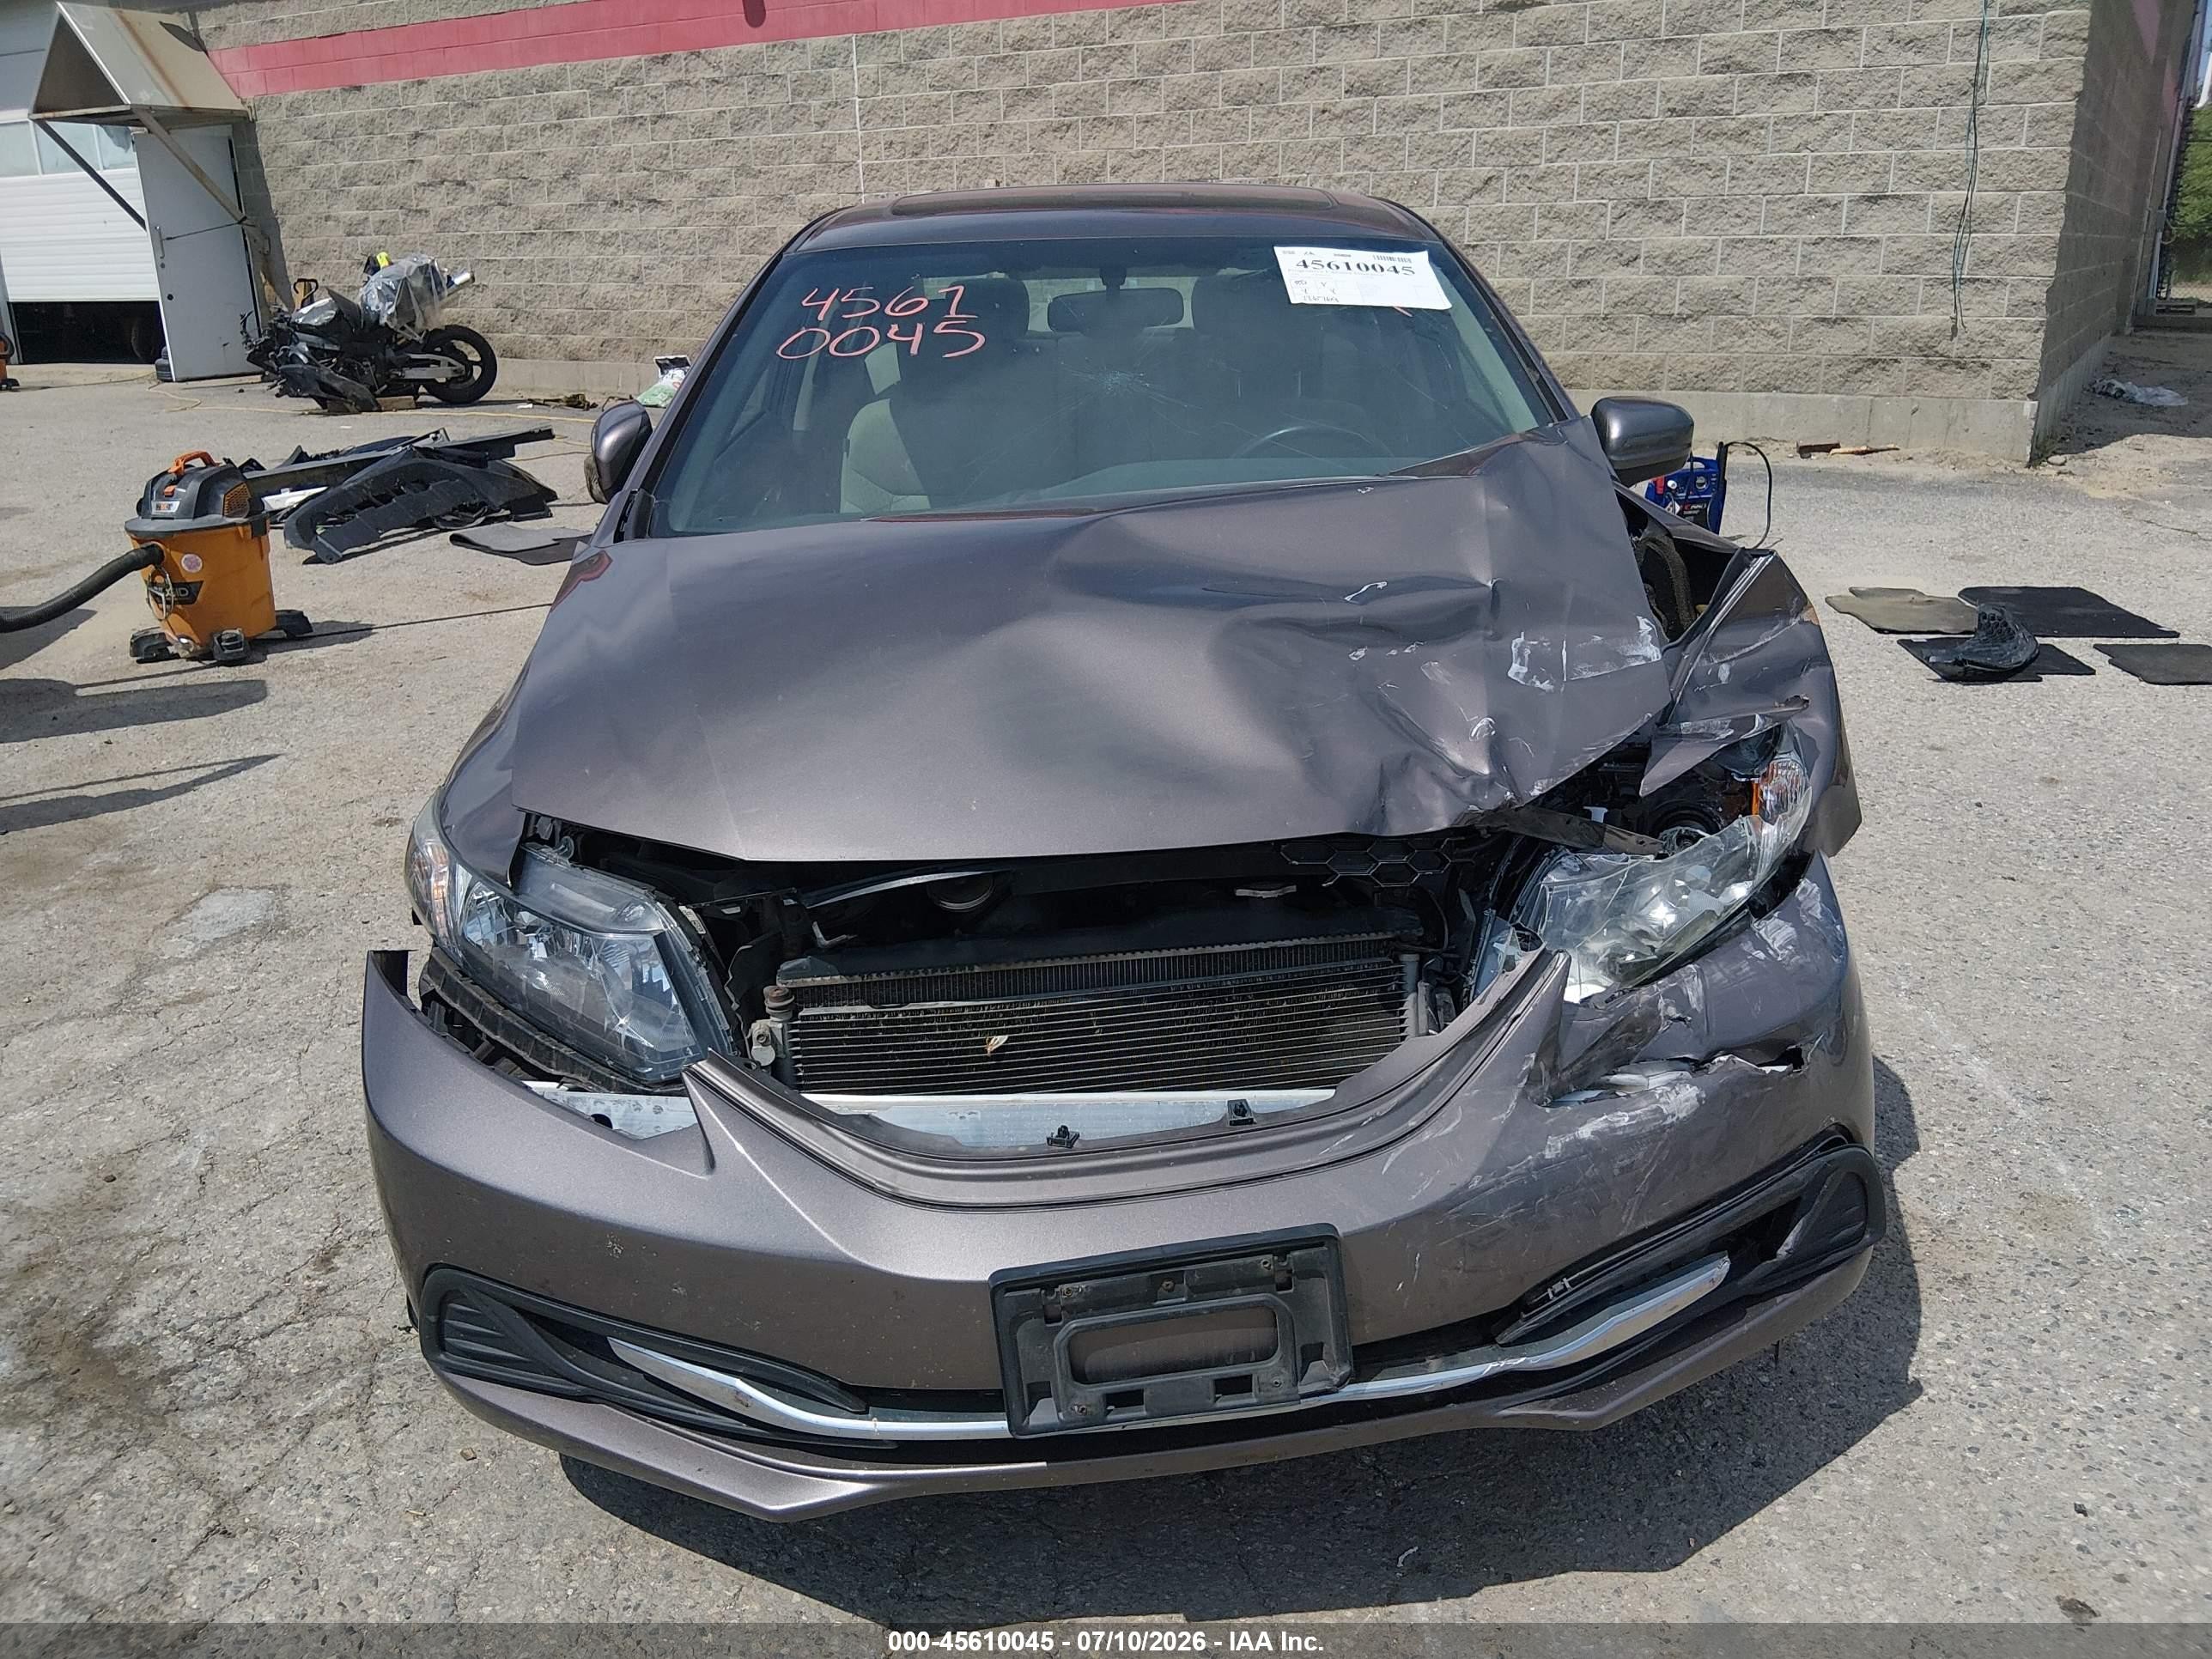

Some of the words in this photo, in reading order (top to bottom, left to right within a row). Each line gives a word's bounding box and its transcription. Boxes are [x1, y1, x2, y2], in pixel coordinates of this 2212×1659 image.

[1296, 259, 1415, 276] 45610045
[800, 284, 979, 321] 4561
[775, 320, 986, 359] 0045
